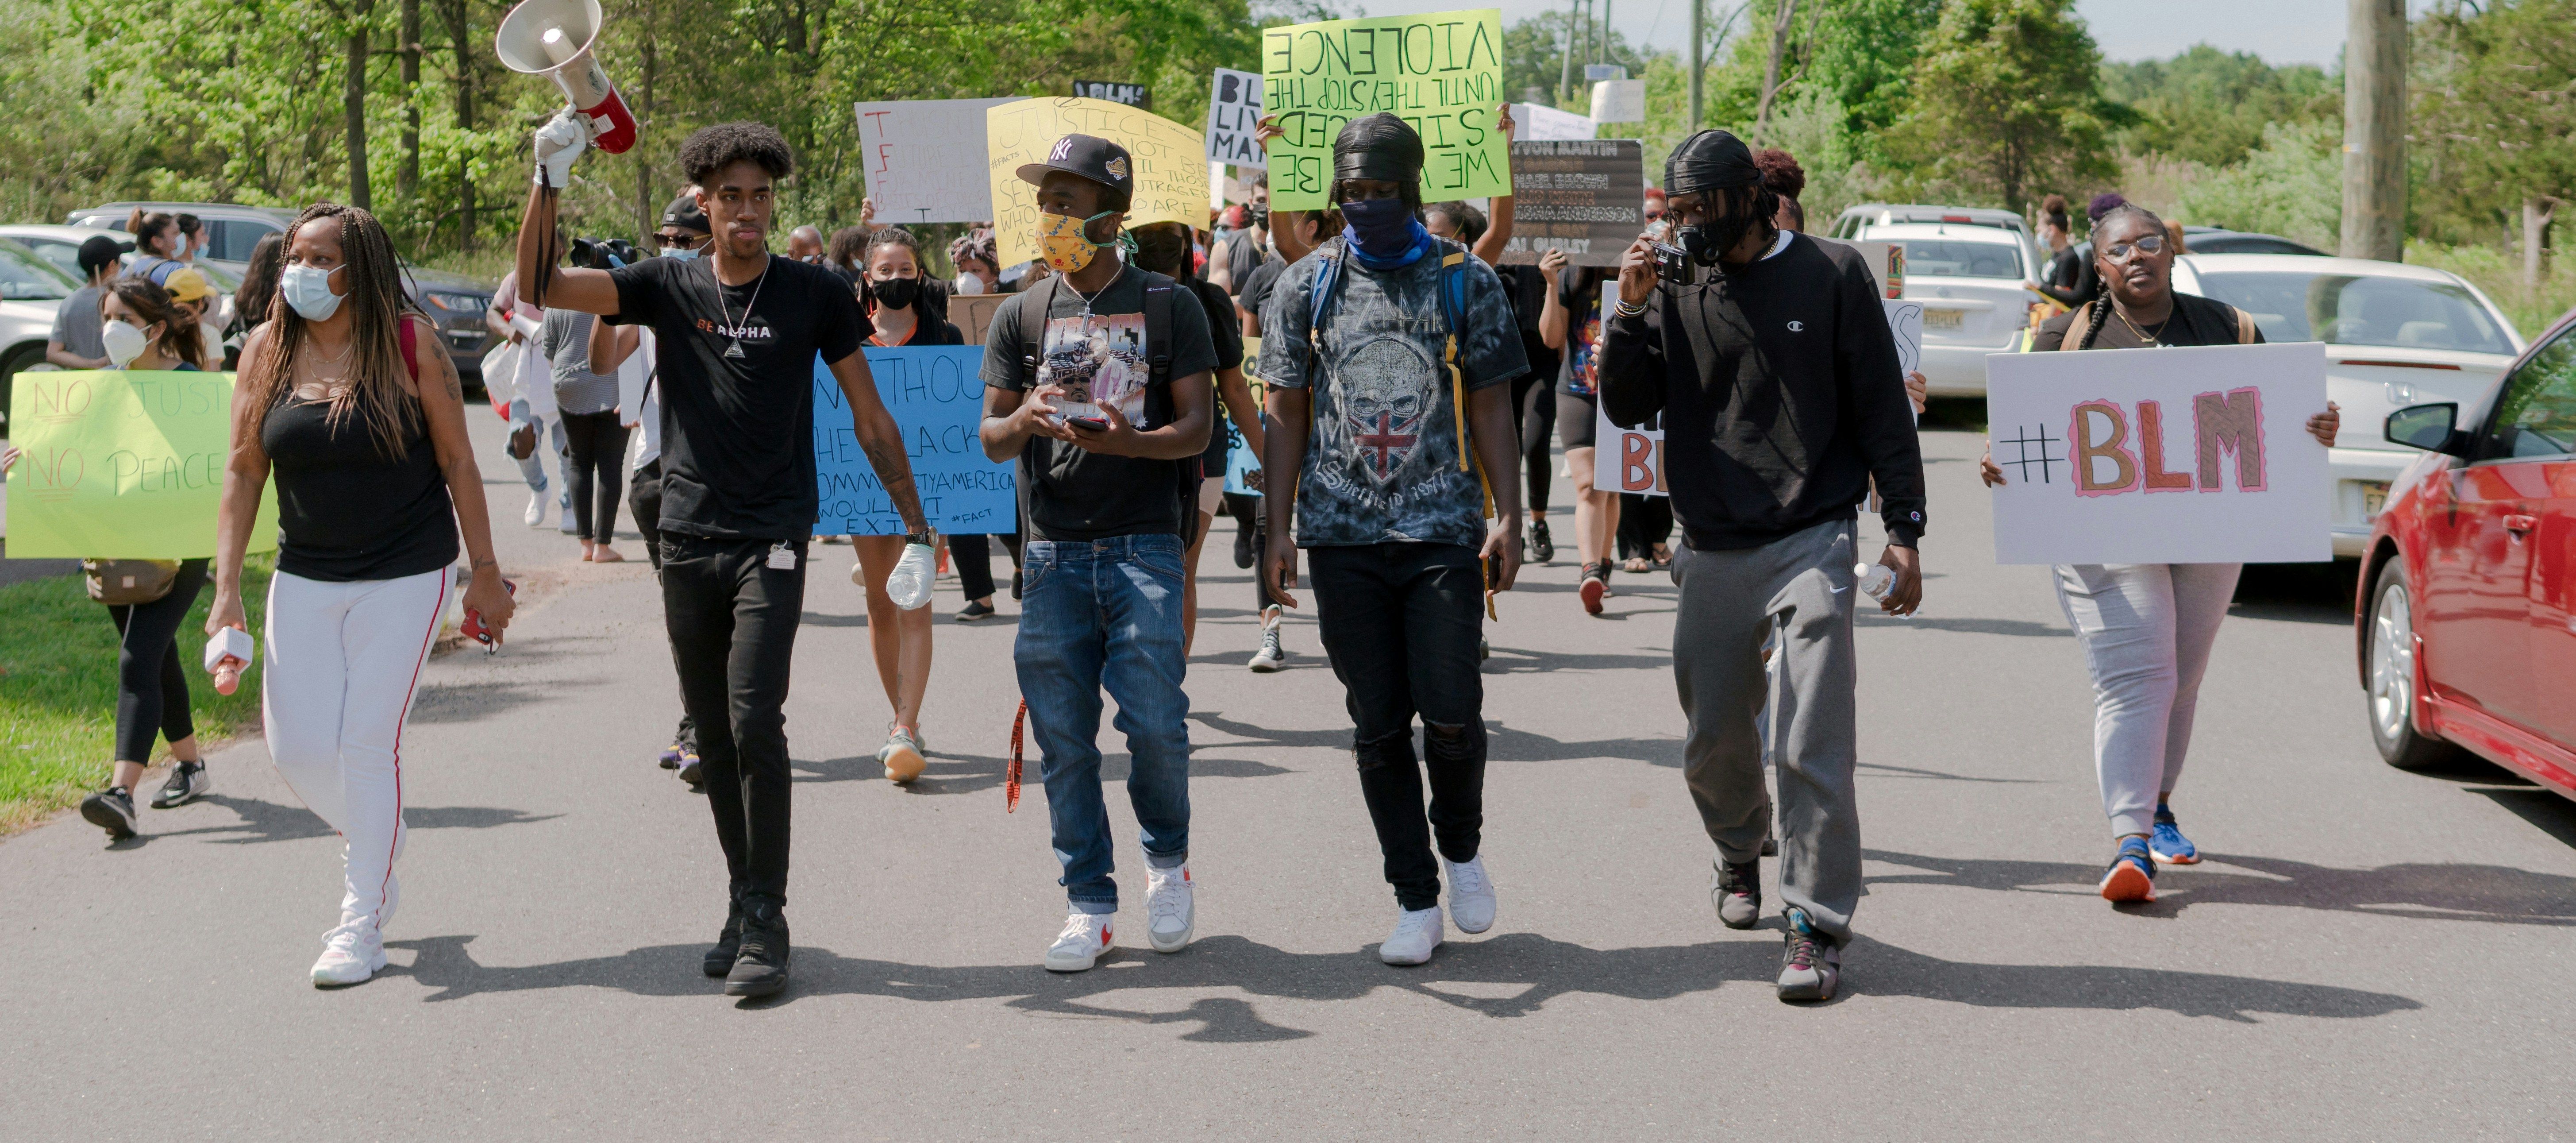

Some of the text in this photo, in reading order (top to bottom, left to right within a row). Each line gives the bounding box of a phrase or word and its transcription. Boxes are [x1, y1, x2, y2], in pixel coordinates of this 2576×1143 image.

[1266, 21, 1498, 76] VIOLENCE
[1265, 78, 1311, 111] THE
[1431, 71, 1494, 106] UNTIL
[1000, 107, 1164, 148] JUSTICE
[990, 151, 1020, 170] #FACTS
[1117, 138, 1207, 179] NOT BE
[1557, 142, 1617, 156] MARTIN
[1164, 170, 1209, 189] THOSE
[1273, 154, 1321, 193] BE
[1440, 149, 1499, 188] WE
[1515, 174, 1609, 189] HAEL BROWN
[1000, 180, 1209, 232] WHO UTRAGED
[1153, 199, 1195, 218] ARE
[1557, 206, 1636, 223] ANDERSON
[1514, 223, 1590, 238] DDIE GRAY
[697, 319, 771, 338] BE ALPHA
[34, 380, 229, 418] NO JUST
[814, 425, 980, 463] HE LACK
[1999, 386, 2267, 498] #BLM
[27, 447, 224, 496] NO PEACE
[951, 508, 992, 524] #FACT
